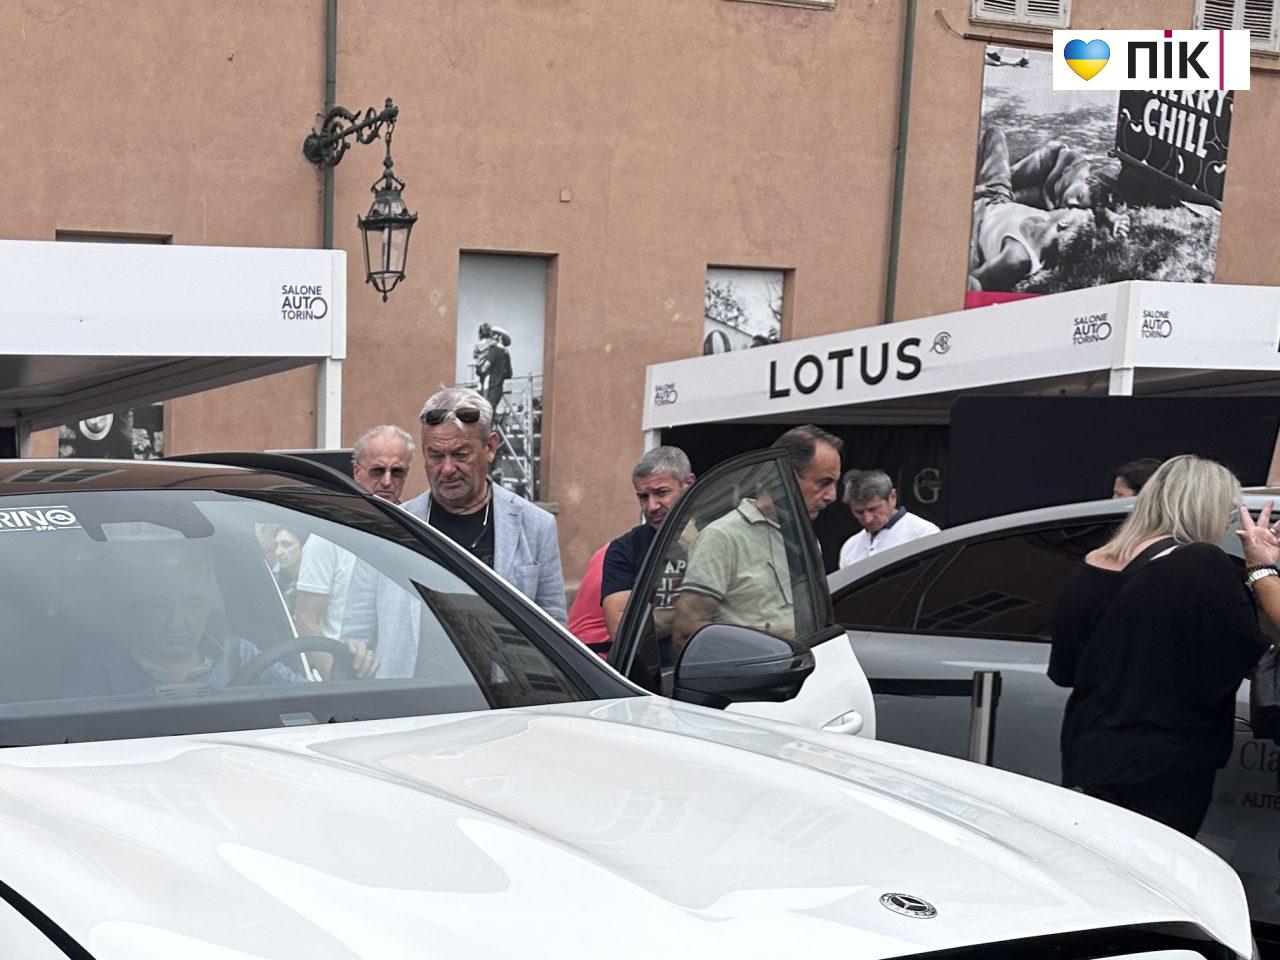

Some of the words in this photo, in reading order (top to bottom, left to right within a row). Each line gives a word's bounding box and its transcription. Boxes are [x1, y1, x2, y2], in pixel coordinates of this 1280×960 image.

[1144, 98, 1209, 158] CHILL
[281, 284, 322, 295] SALONE
[282, 296, 328, 319] AUTO
[1143, 309, 1170, 319] SALONE
[1074, 313, 1108, 325] SALONE
[1073, 322, 1112, 340] AUTO
[1142, 319, 1172, 338] AUTO
[770, 337, 922, 399] LOTUS
